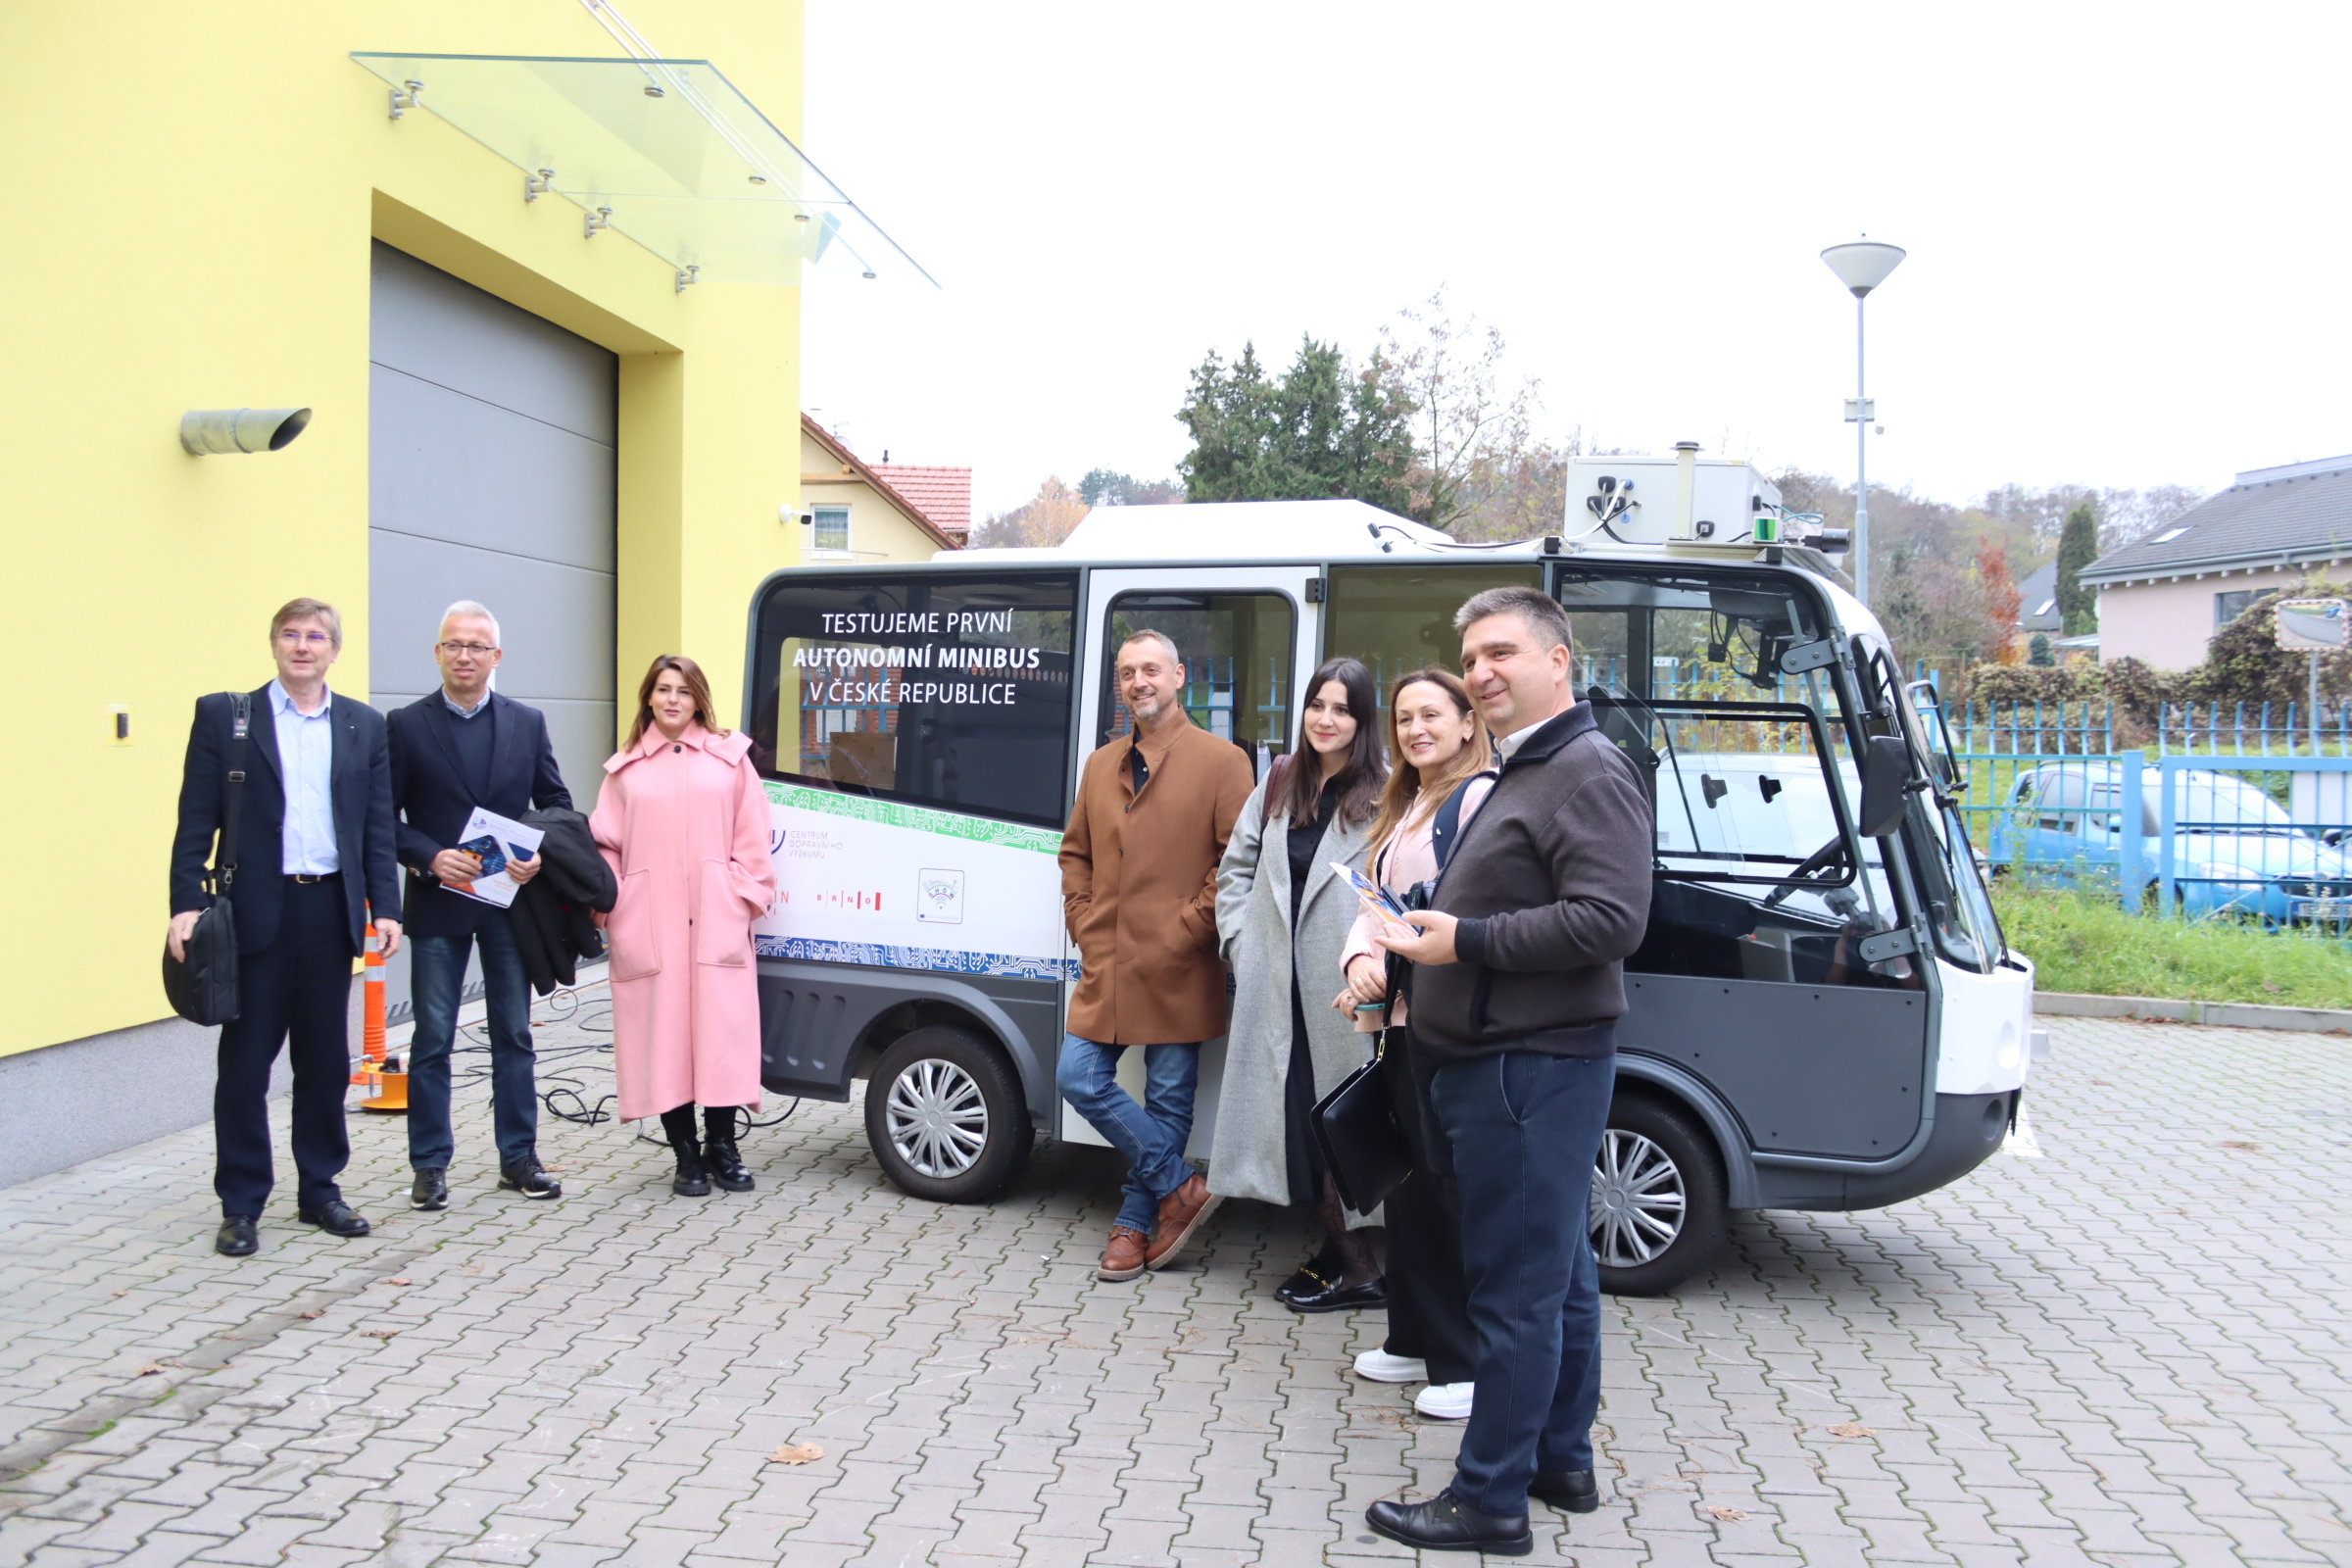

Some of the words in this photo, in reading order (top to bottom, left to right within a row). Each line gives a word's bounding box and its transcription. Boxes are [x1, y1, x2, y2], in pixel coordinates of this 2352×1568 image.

[822, 612, 939, 634] TESTUJEME
[947, 609, 1014, 633] PRVNÍ
[793, 644, 931, 667] AUTONOMNÍ
[938, 648, 1040, 668] MINIBUS
[810, 681, 823, 702] V
[829, 677, 892, 703] ČESKÉ
[900, 682, 1016, 705] REPUBLICE
[790, 830, 828, 840] CENTRUM
[789, 840, 843, 851] DOPRAVNÍHO
[928, 887, 956, 899] SHOW
